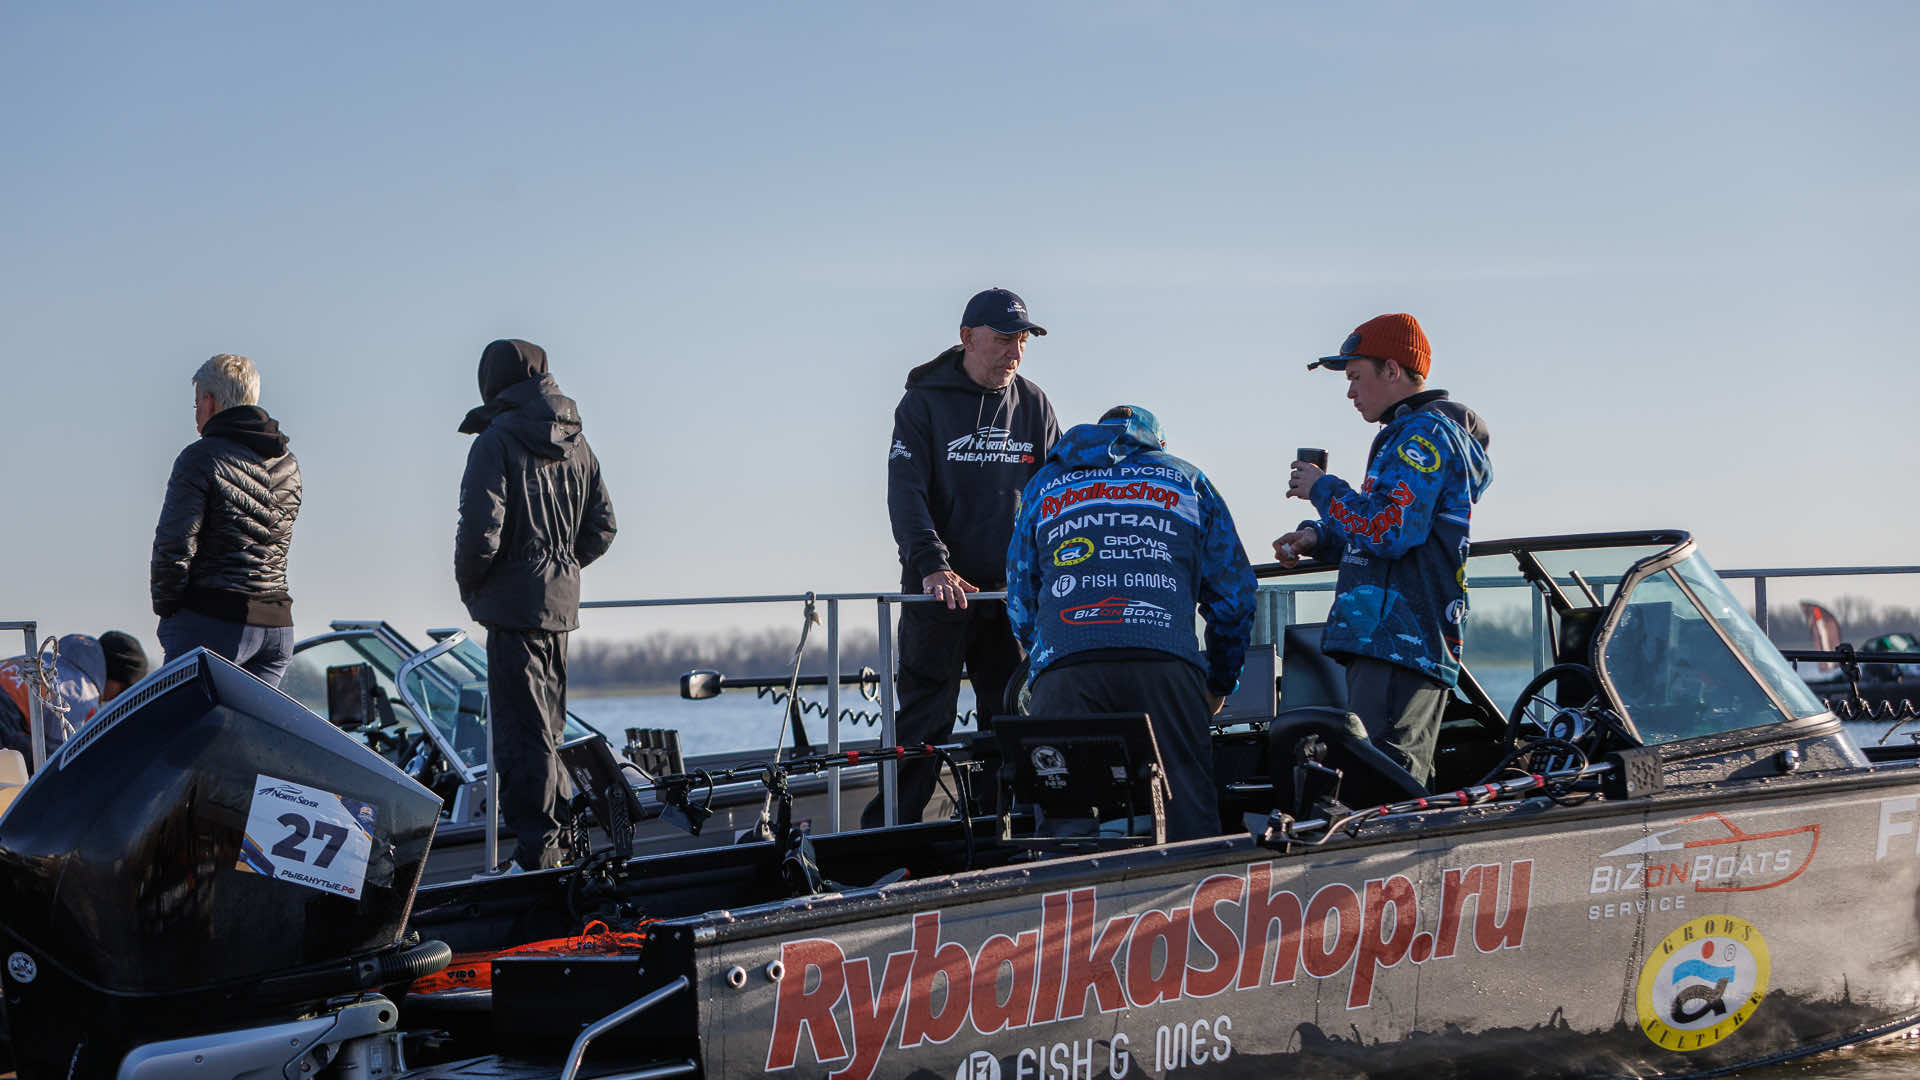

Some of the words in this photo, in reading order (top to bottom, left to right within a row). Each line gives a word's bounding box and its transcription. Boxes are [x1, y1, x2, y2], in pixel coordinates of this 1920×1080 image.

[1040, 467, 1113, 496] МАКСИМ
[1120, 466, 1184, 483] РУСЯЕВ
[1041, 480, 1180, 520] RybalkaShop
[1047, 512, 1178, 545] FINNTRAIL
[1103, 534, 1168, 551] GROWS
[1082, 573, 1117, 589] FISH
[1124, 573, 1177, 592] GAMES
[1124, 617, 1171, 629] SERVICE
[271, 812, 349, 869] 27
[1587, 895, 1686, 920] SERVICE
[1663, 919, 1753, 955] GROWS
[764, 857, 1535, 1080] RybalkaShop.ru
[1016, 1037, 1093, 1080] FISH
